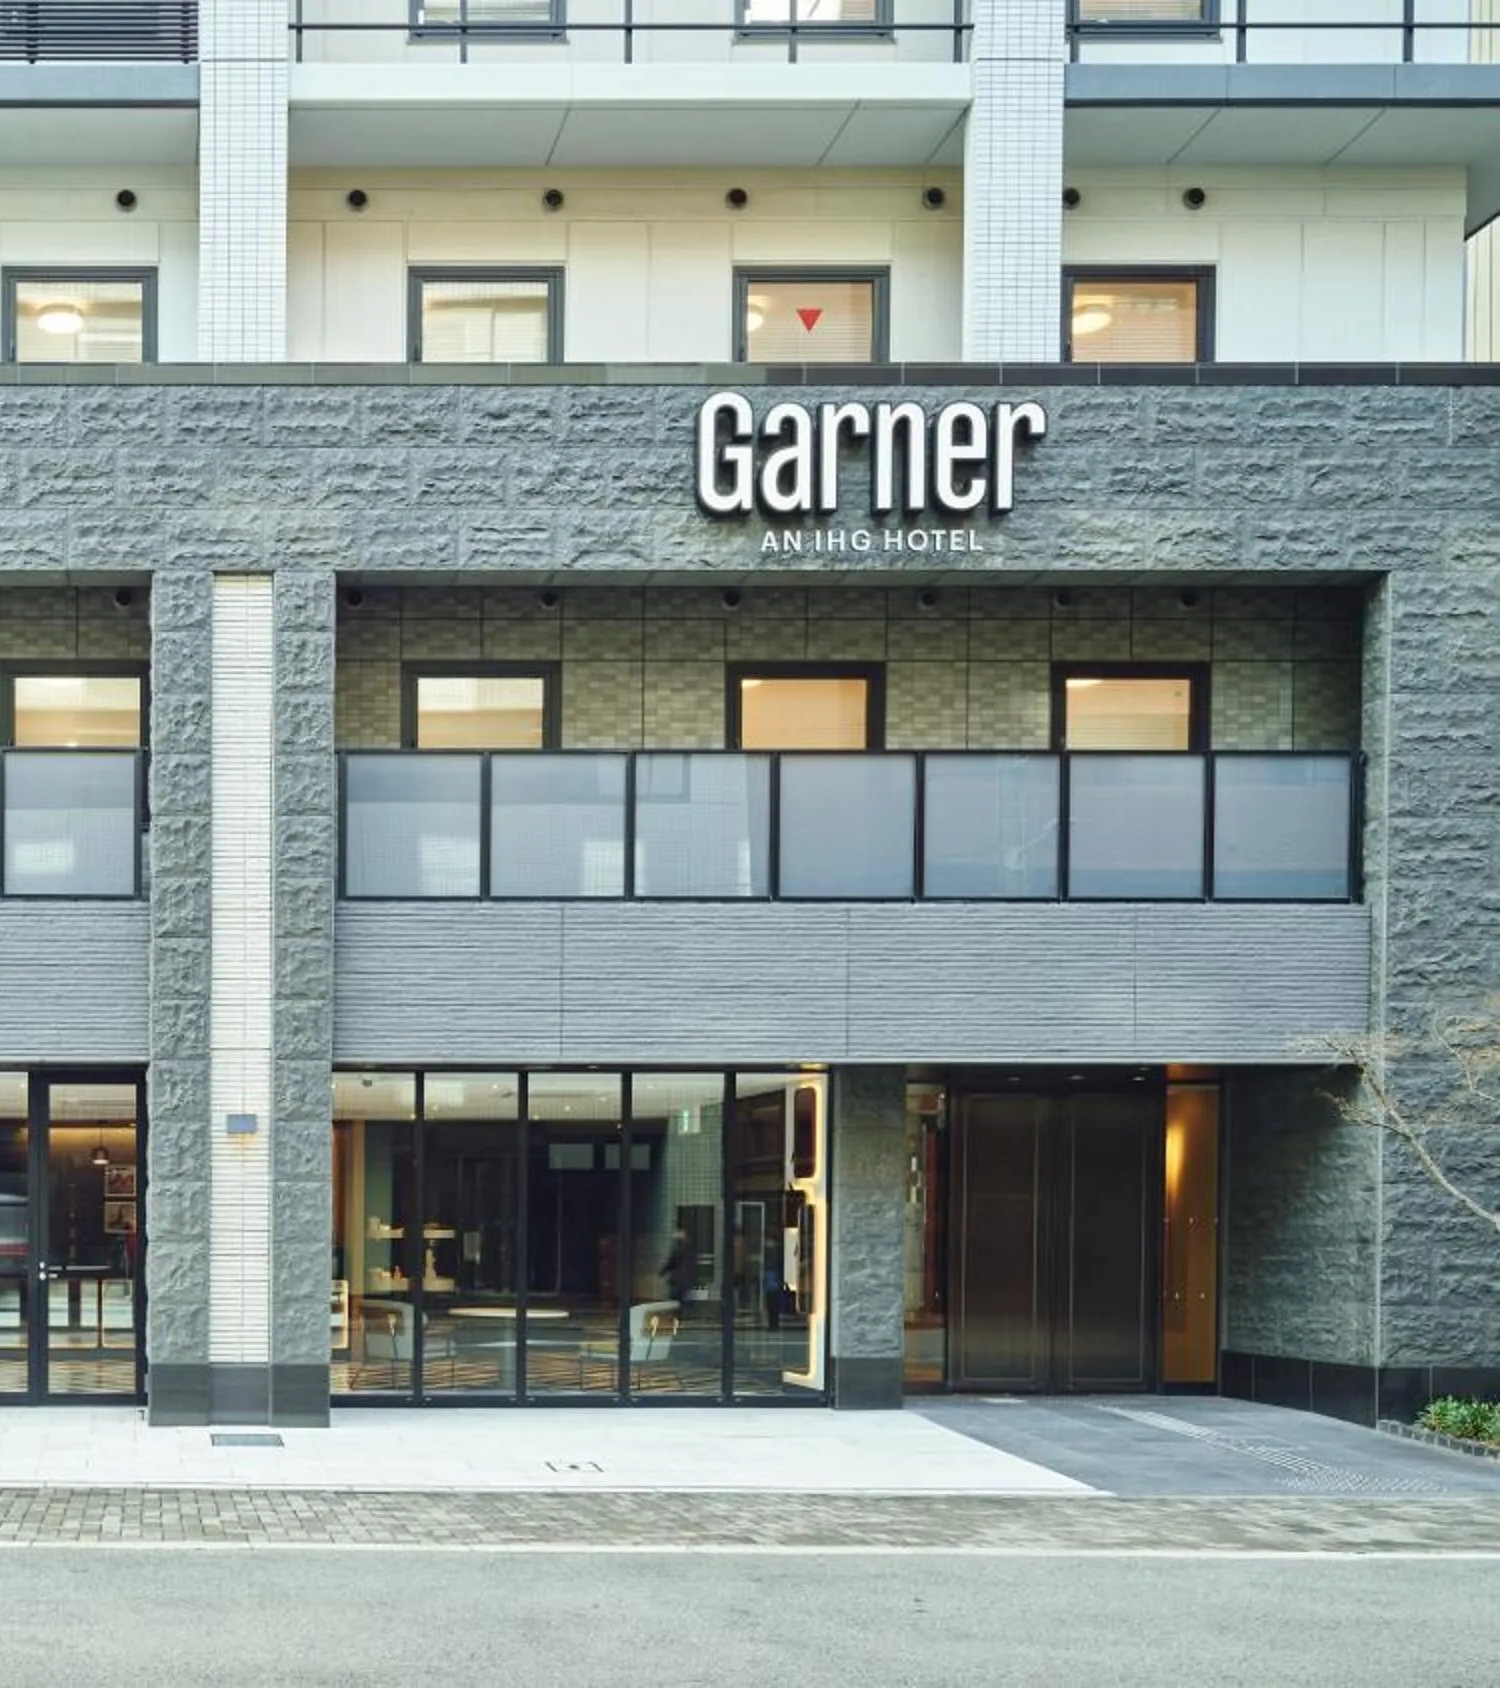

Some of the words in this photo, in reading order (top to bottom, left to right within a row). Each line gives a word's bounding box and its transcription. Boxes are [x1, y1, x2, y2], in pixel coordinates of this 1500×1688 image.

[699, 391, 1045, 510] Garner
[760, 530, 802, 552] AN
[814, 529, 871, 552] IHG
[884, 529, 984, 552] HOTEL
